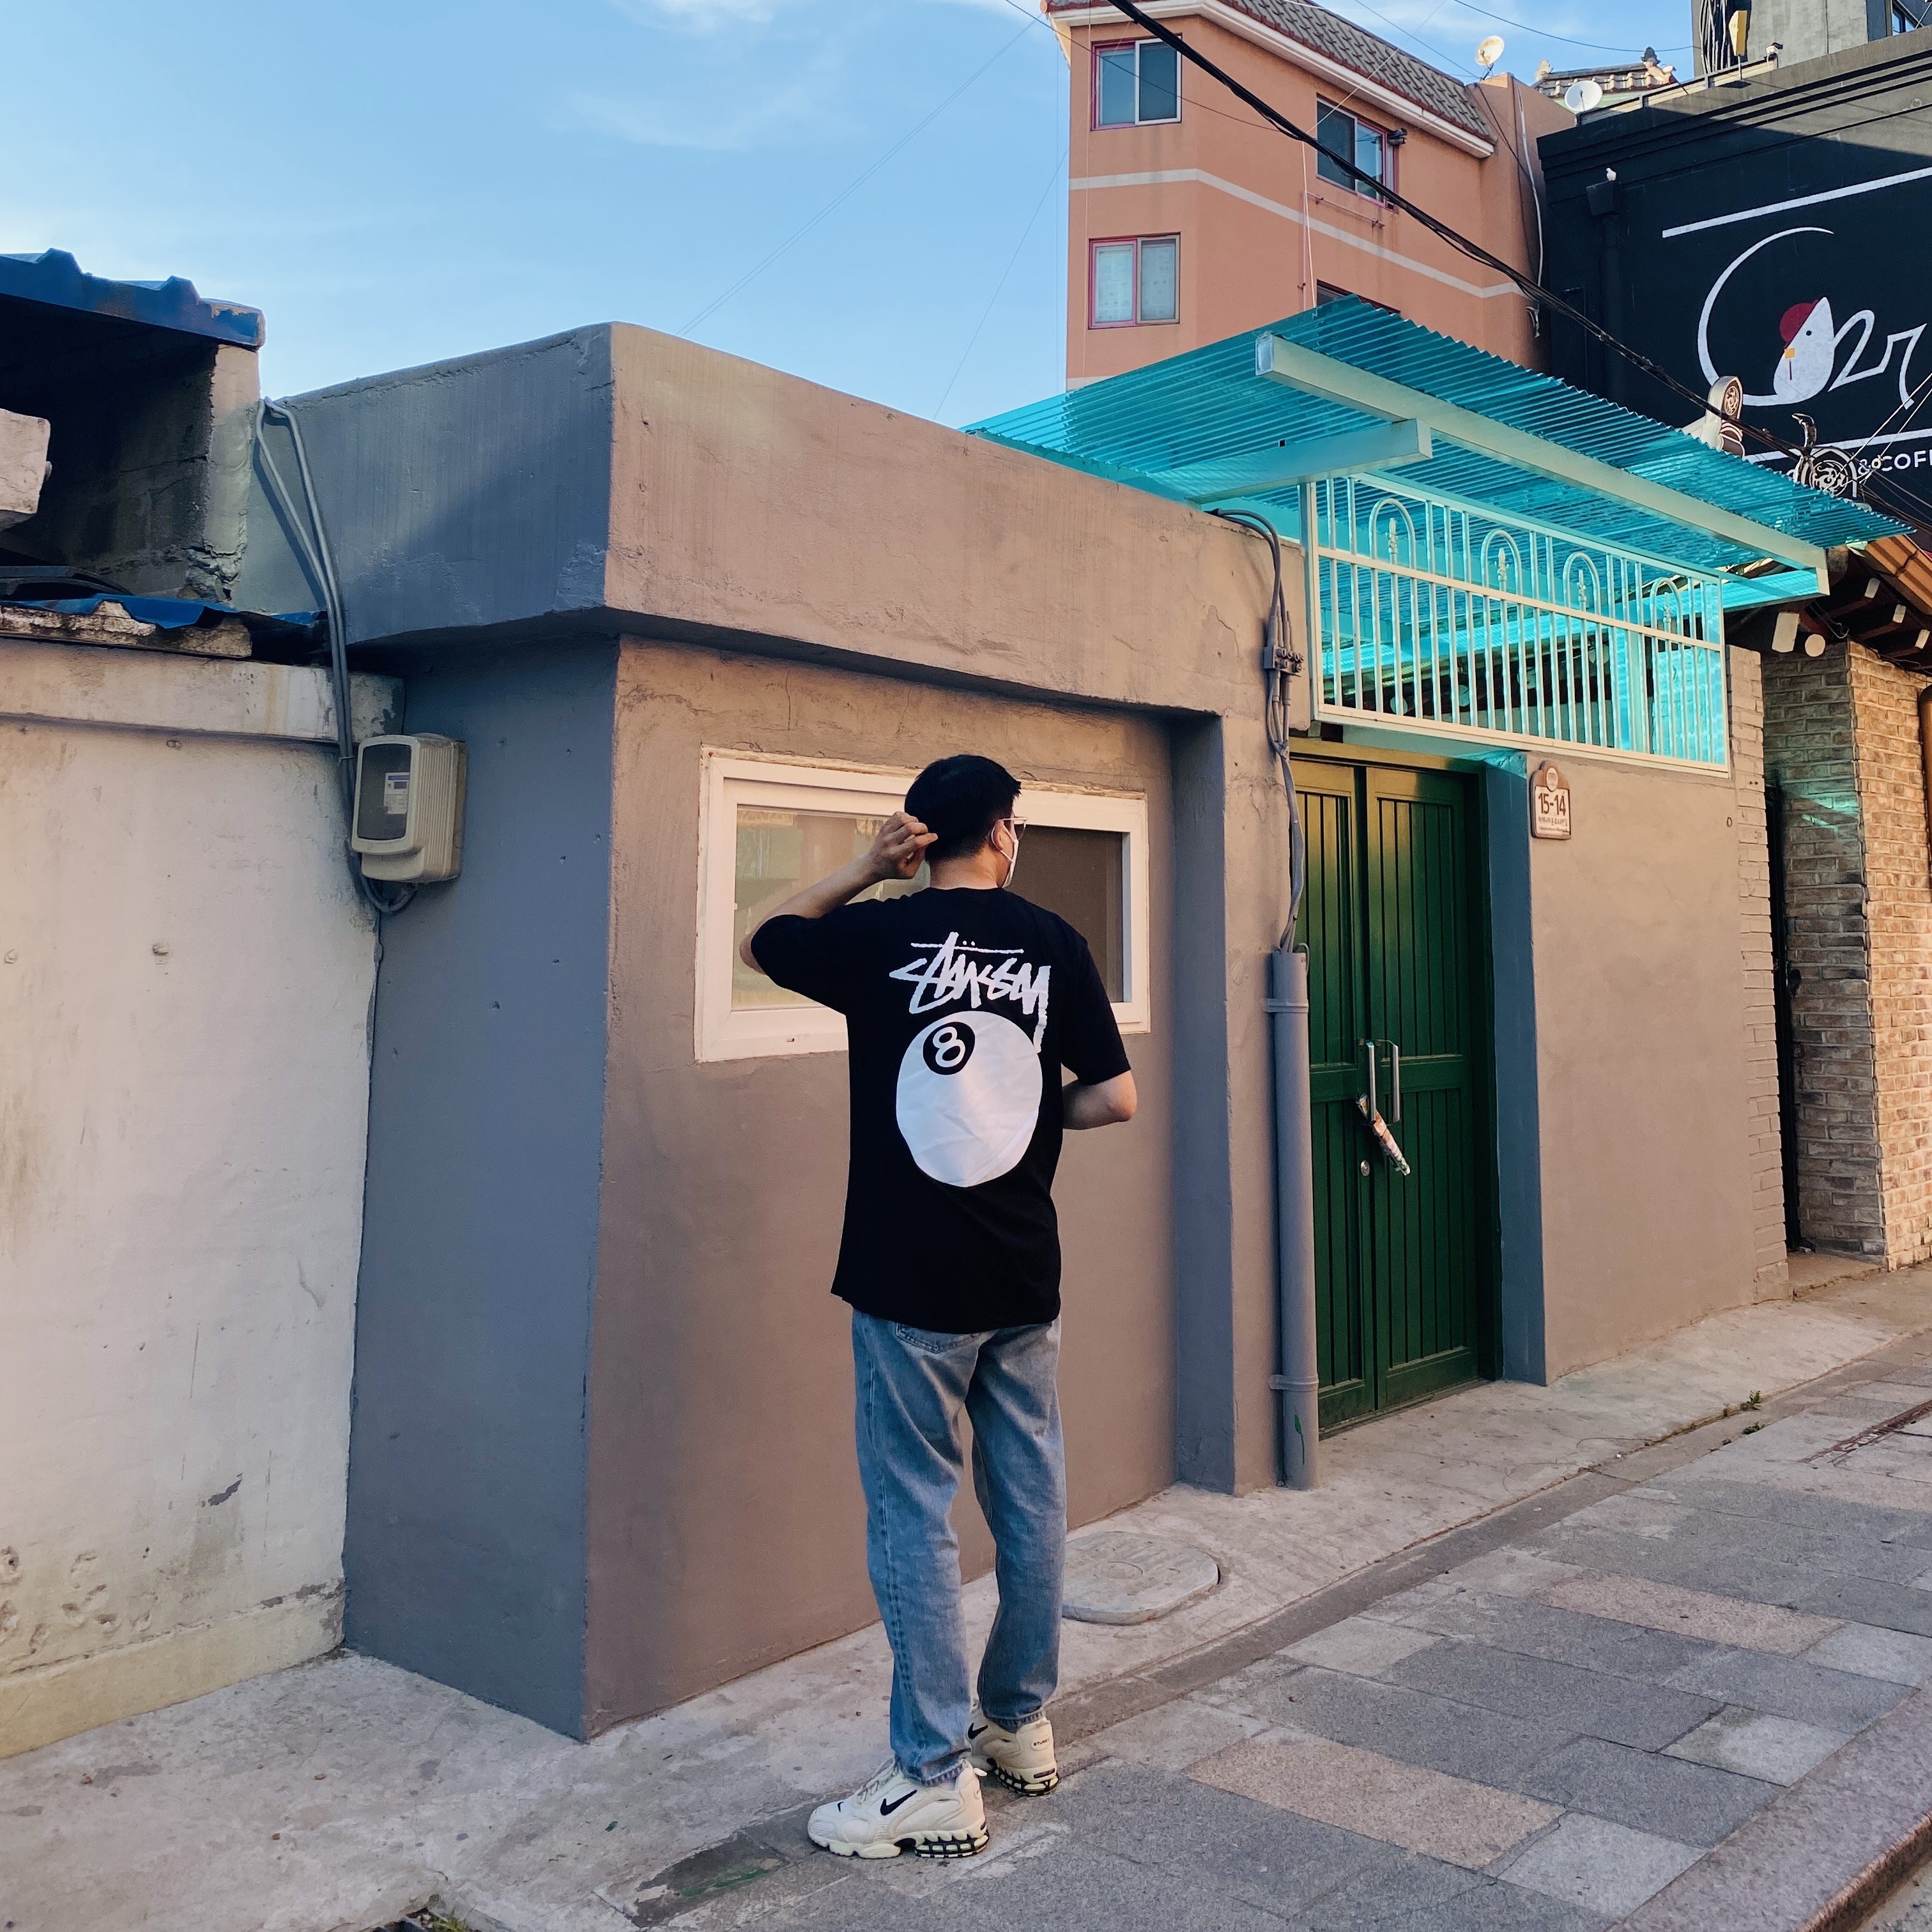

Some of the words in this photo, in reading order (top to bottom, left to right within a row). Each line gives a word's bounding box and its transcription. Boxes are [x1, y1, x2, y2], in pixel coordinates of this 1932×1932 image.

[1880, 449, 1932, 471] COF
[1538, 793, 1566, 816] 15-14
[932, 1026, 966, 1068] 8
